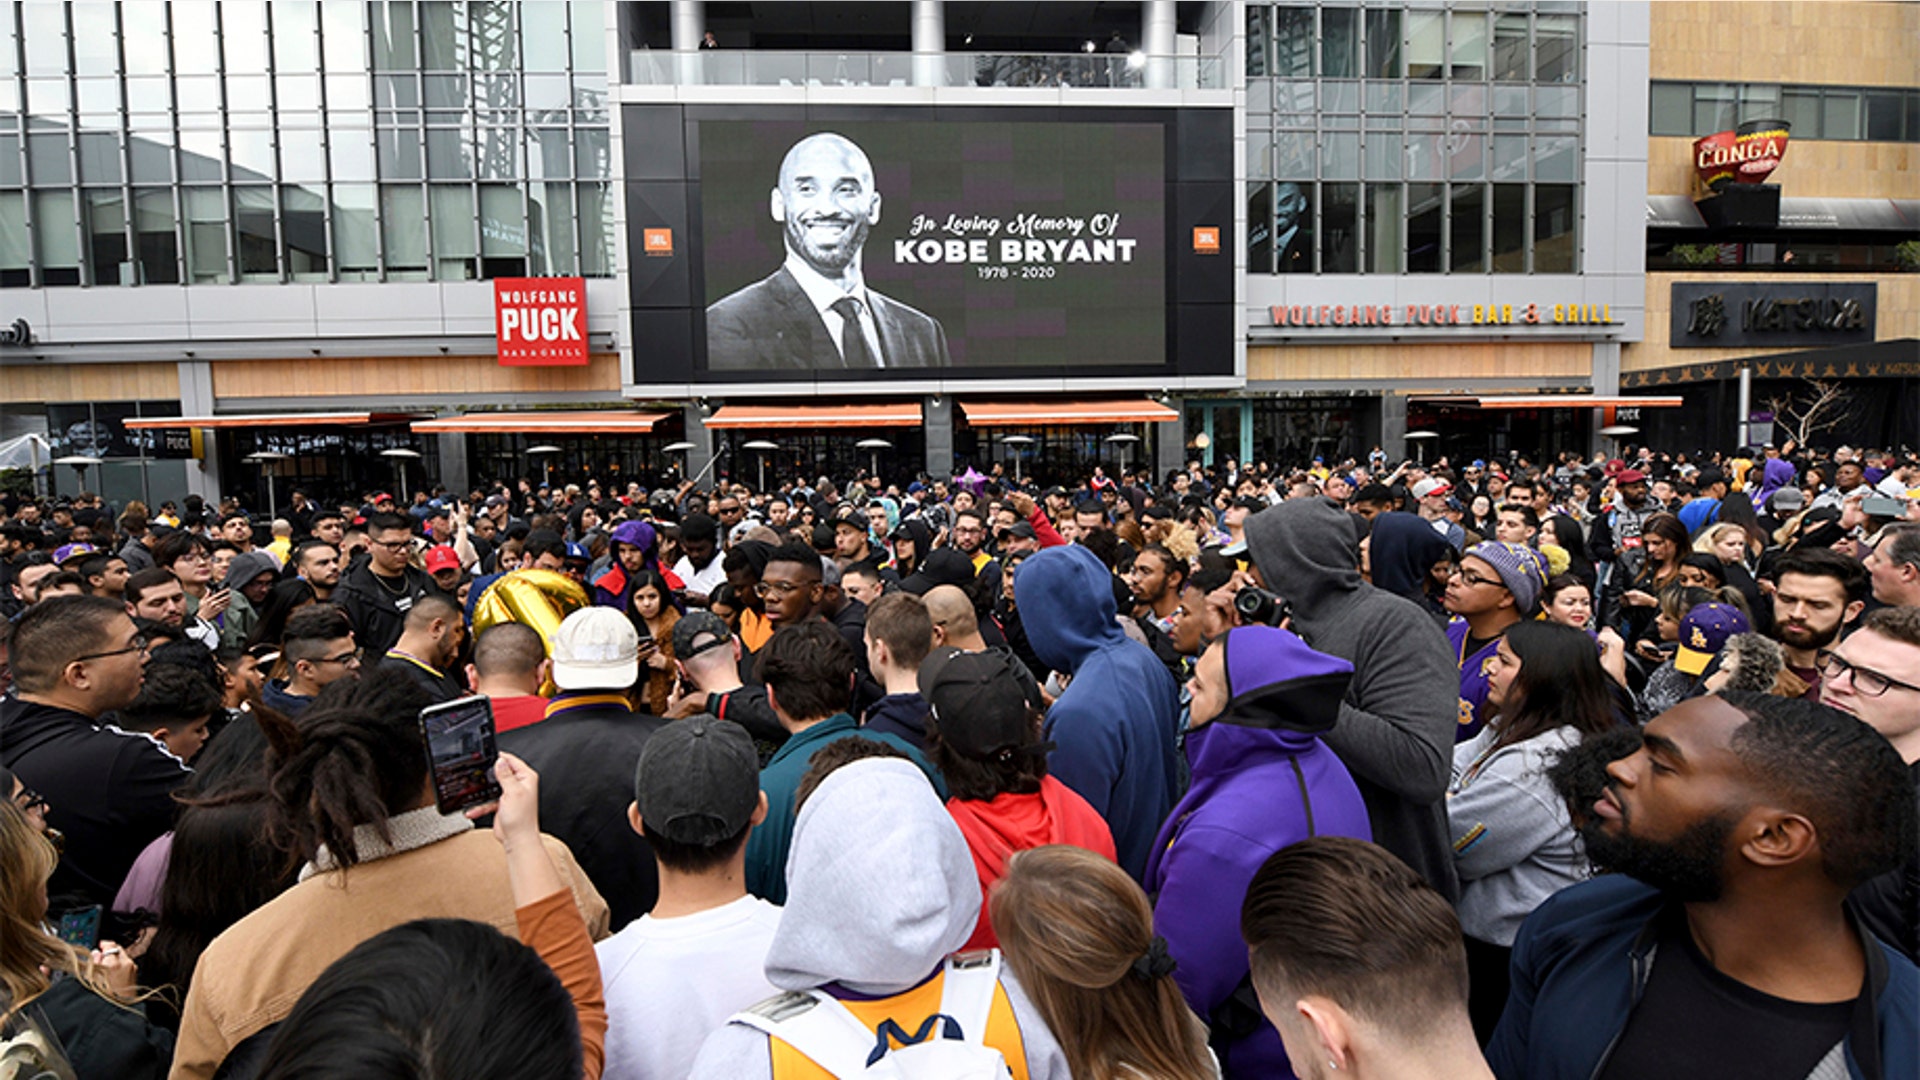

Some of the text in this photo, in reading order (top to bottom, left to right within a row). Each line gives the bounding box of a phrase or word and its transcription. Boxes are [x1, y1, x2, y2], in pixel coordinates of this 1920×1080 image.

[1698, 139, 1779, 169] CONGA
[910, 213, 1120, 238] In Loving Memory Of
[894, 239, 1137, 263] KOBE BRYANT
[978, 267, 1009, 279] 1978
[1021, 267, 1055, 279] 2020
[500, 290, 577, 304] WOLFGANG
[501, 308, 581, 341] PUCK
[1270, 303, 1613, 325] WOLFGANG PUCK BAR & GRILL
[1742, 297, 1868, 331] KATSUYA
[167, 437, 191, 449] PUCK
